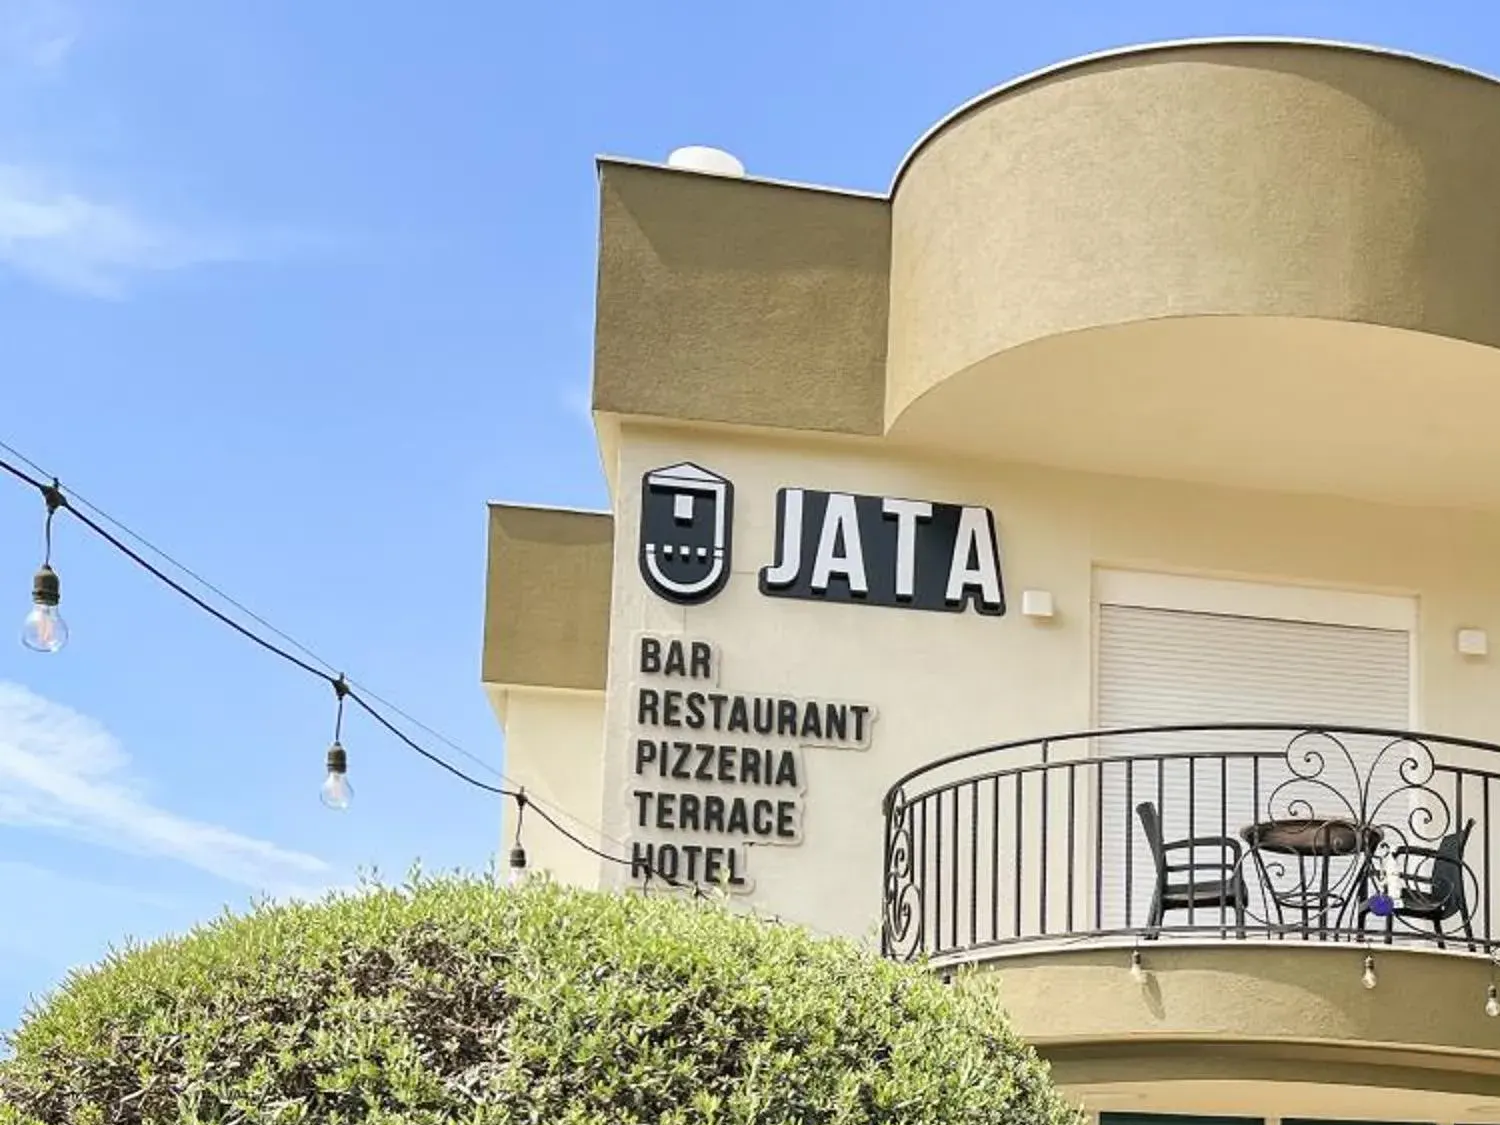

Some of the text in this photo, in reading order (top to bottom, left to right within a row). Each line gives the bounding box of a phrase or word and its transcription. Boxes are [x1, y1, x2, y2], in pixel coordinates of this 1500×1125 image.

[766, 488, 1002, 604] JATA
[640, 637, 711, 679] BAR
[638, 688, 869, 741] RESTAURANT
[635, 739, 797, 787] PIZZERIA
[633, 790, 796, 837] TERRACE
[631, 842, 745, 885] HOTEL
